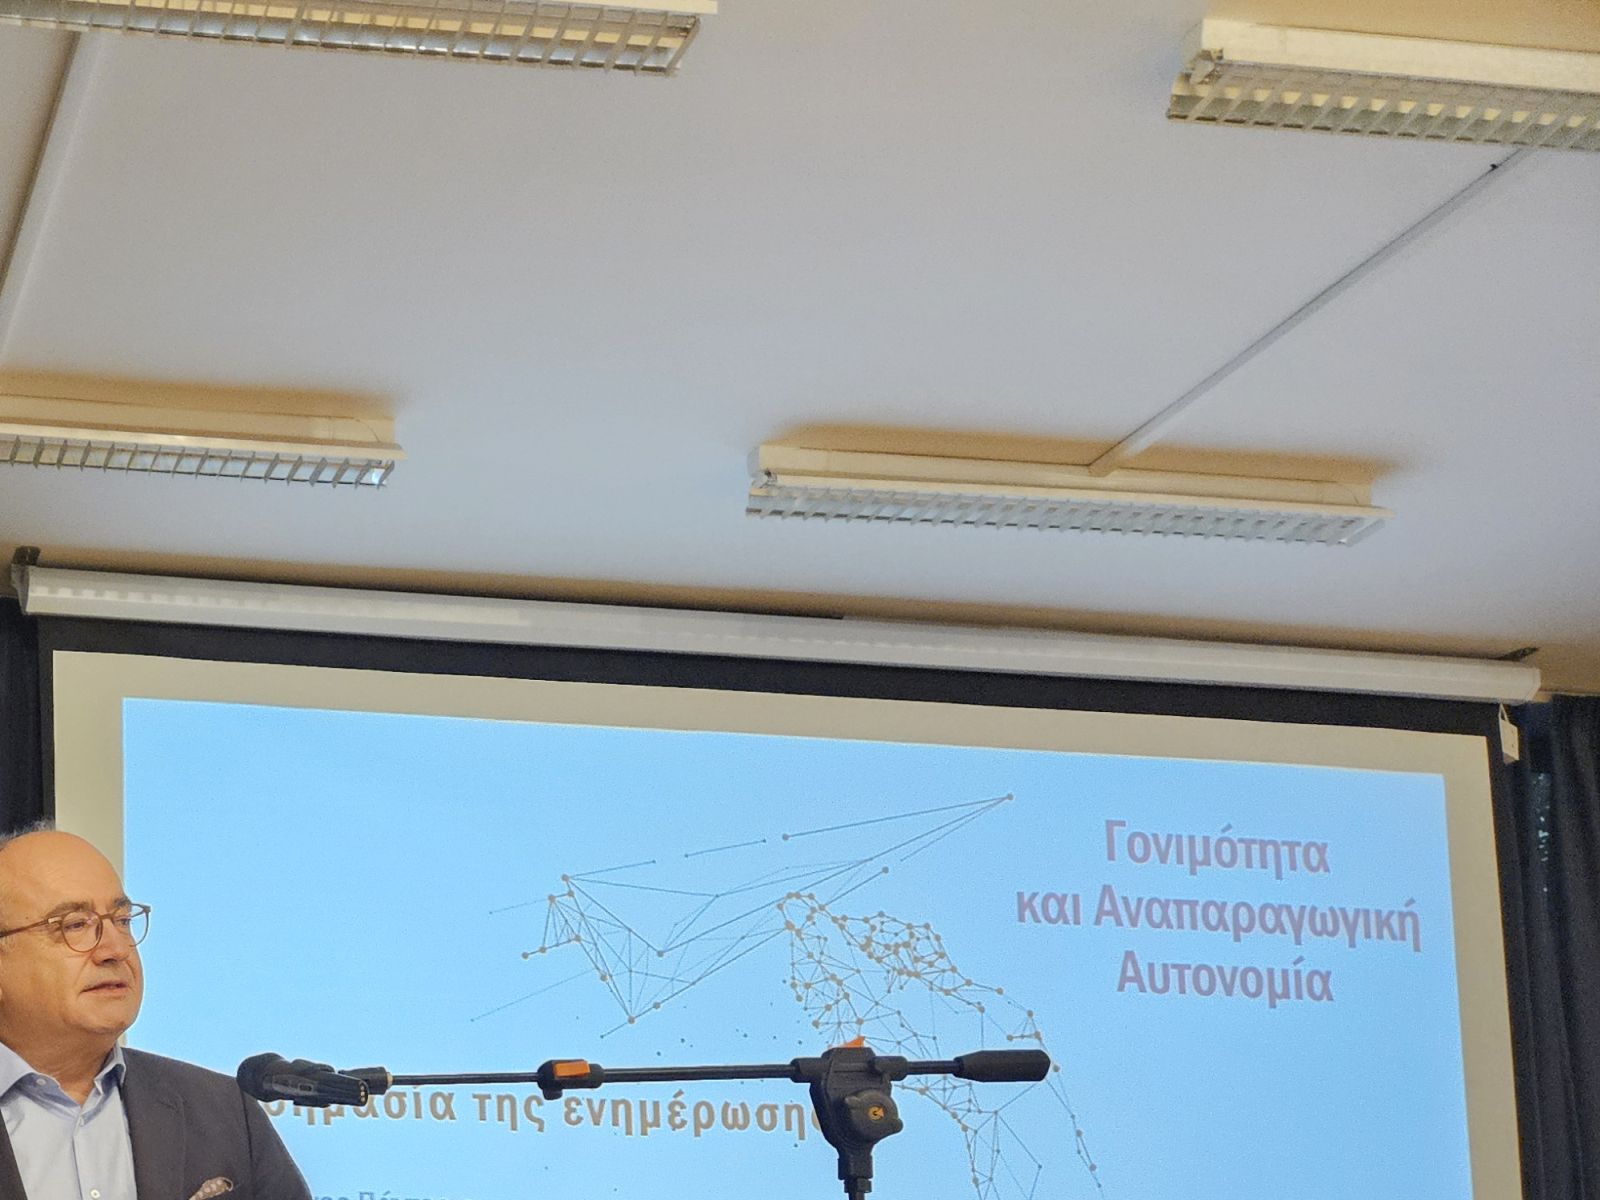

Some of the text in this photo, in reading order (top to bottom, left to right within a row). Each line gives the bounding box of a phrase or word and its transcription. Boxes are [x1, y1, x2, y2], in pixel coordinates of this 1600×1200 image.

[1104, 819, 1331, 880] Γονιμότητα
[1016, 884, 1422, 953] και Αναπαραγωγική
[1117, 950, 1334, 1009] Αυτονομία
[472, 1091, 545, 1132] της
